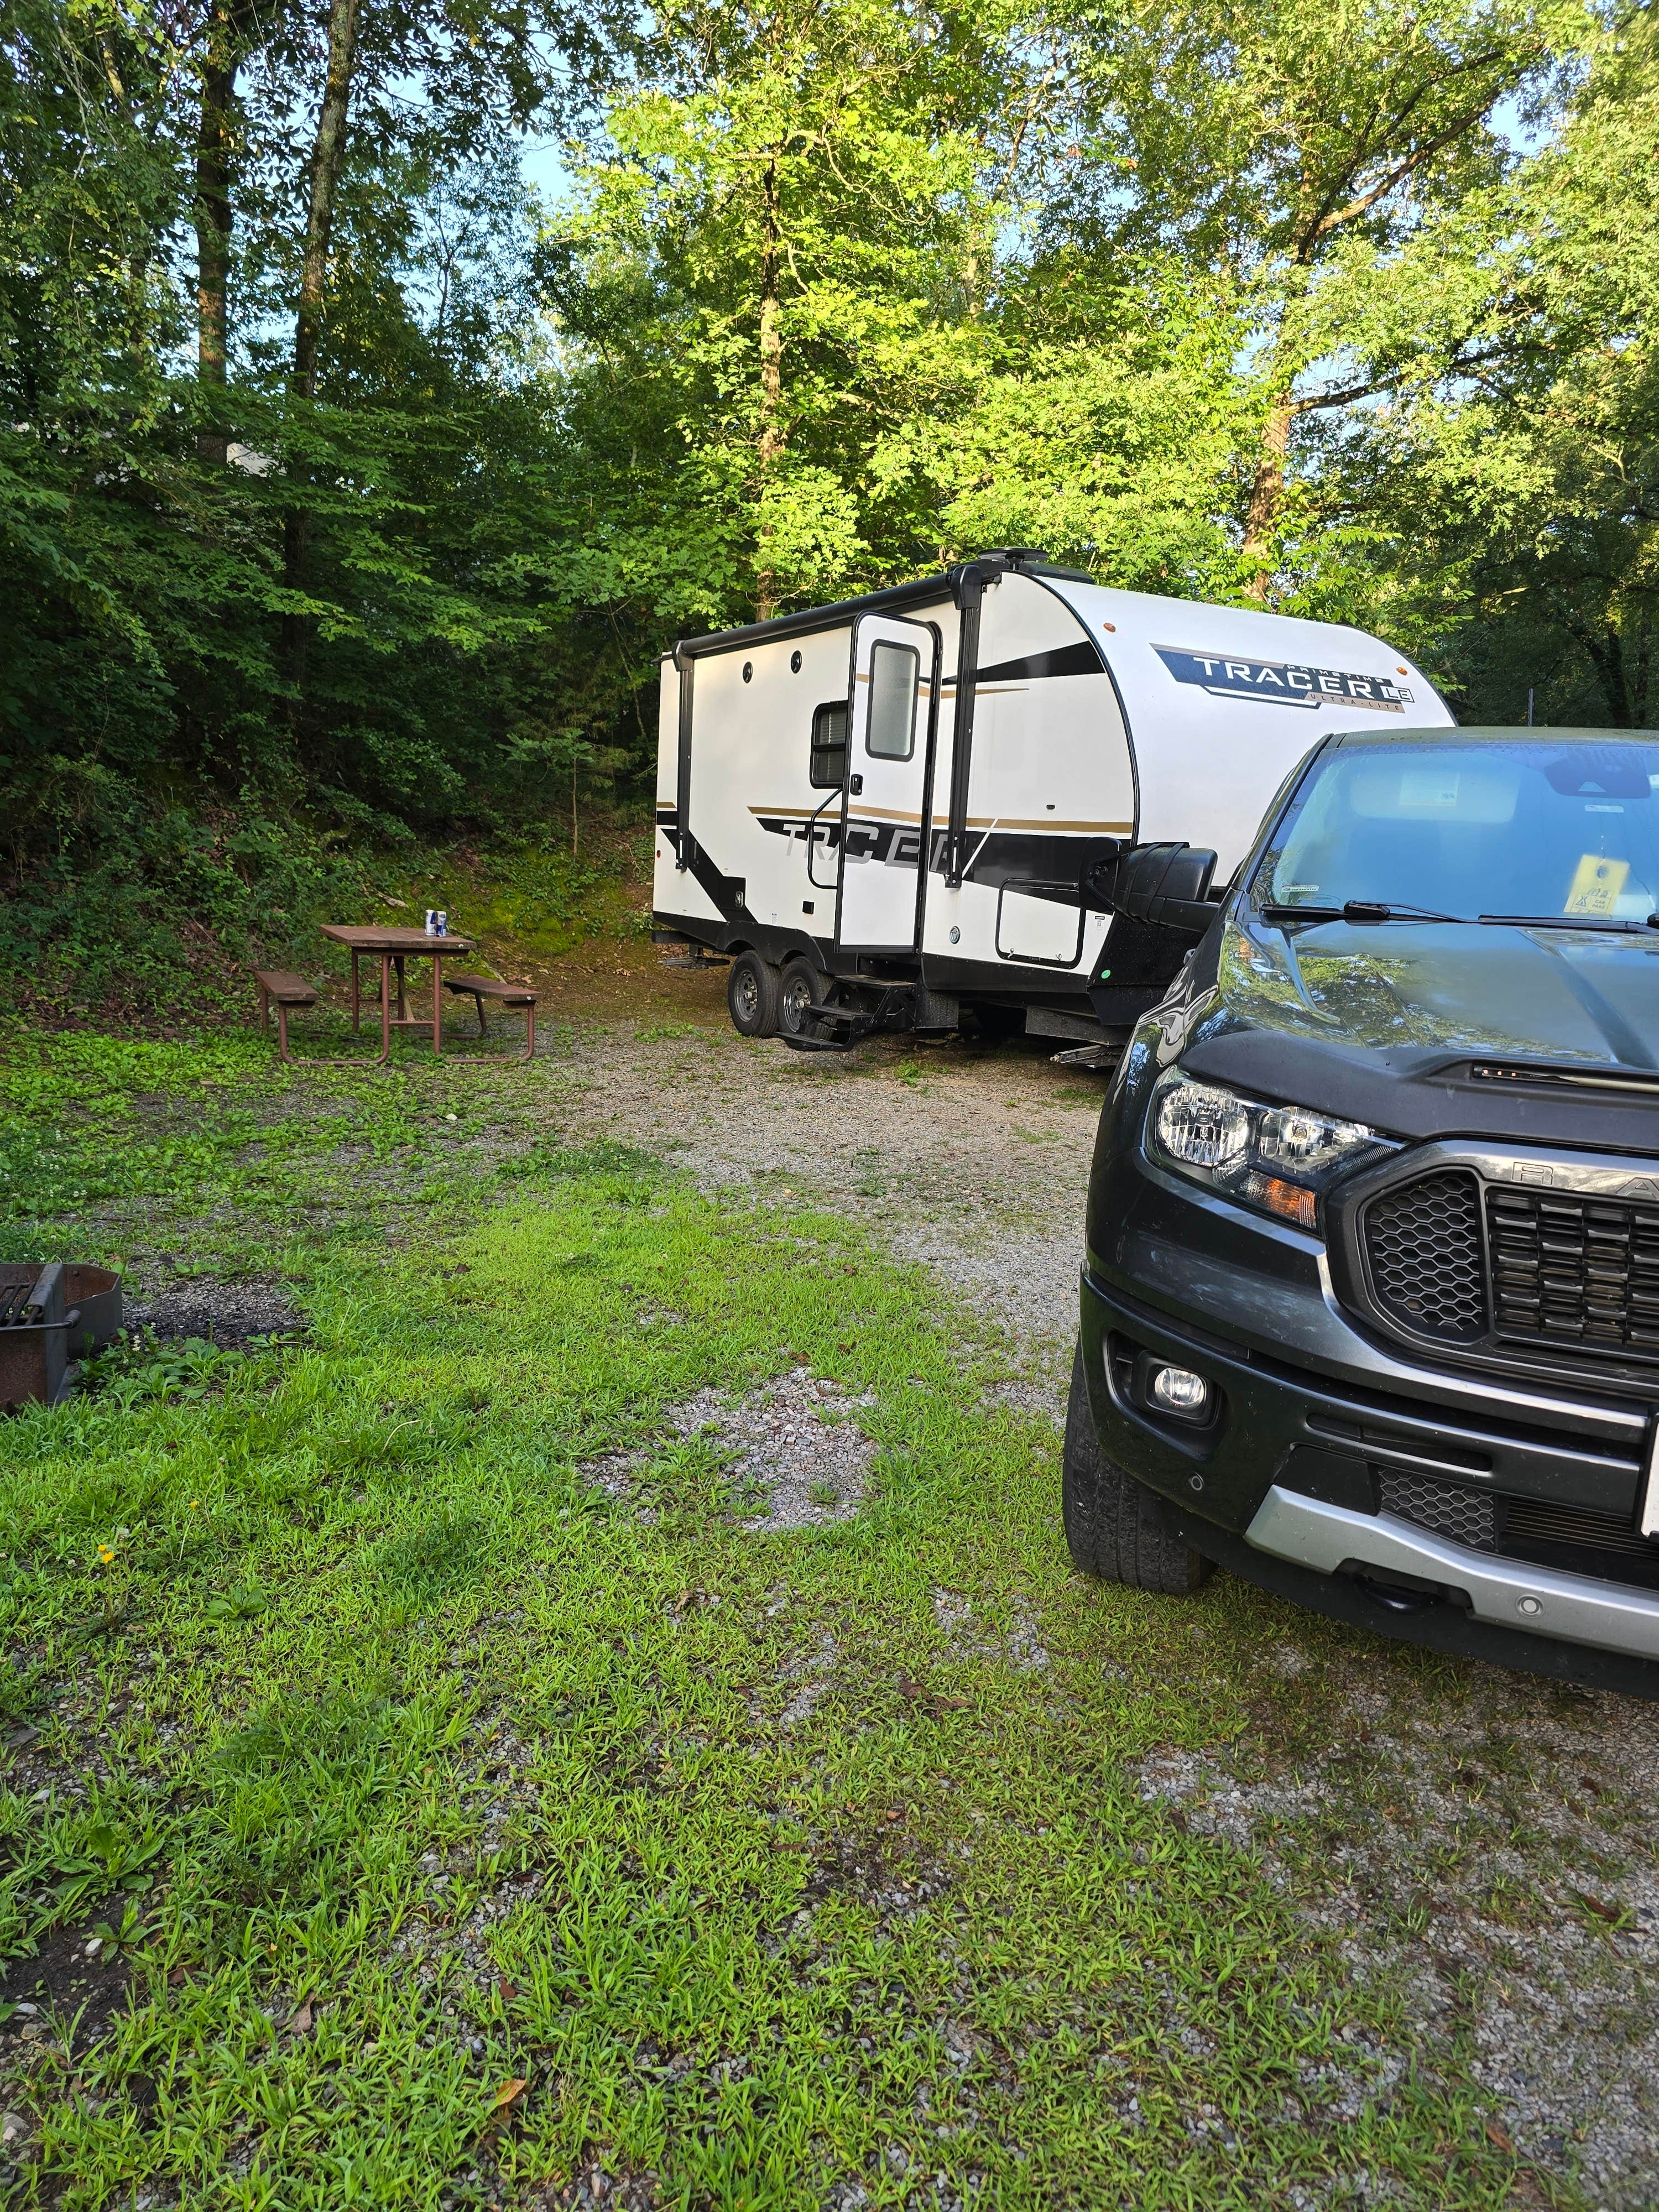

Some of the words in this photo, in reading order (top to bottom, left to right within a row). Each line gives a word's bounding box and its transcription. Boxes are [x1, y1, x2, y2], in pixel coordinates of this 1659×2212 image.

[1193, 656, 1375, 699] TRACER
[1382, 686, 1413, 702] LE
[1286, 665, 1384, 683] PRIMETIME
[1311, 693, 1400, 711] ULTRA-LITE
